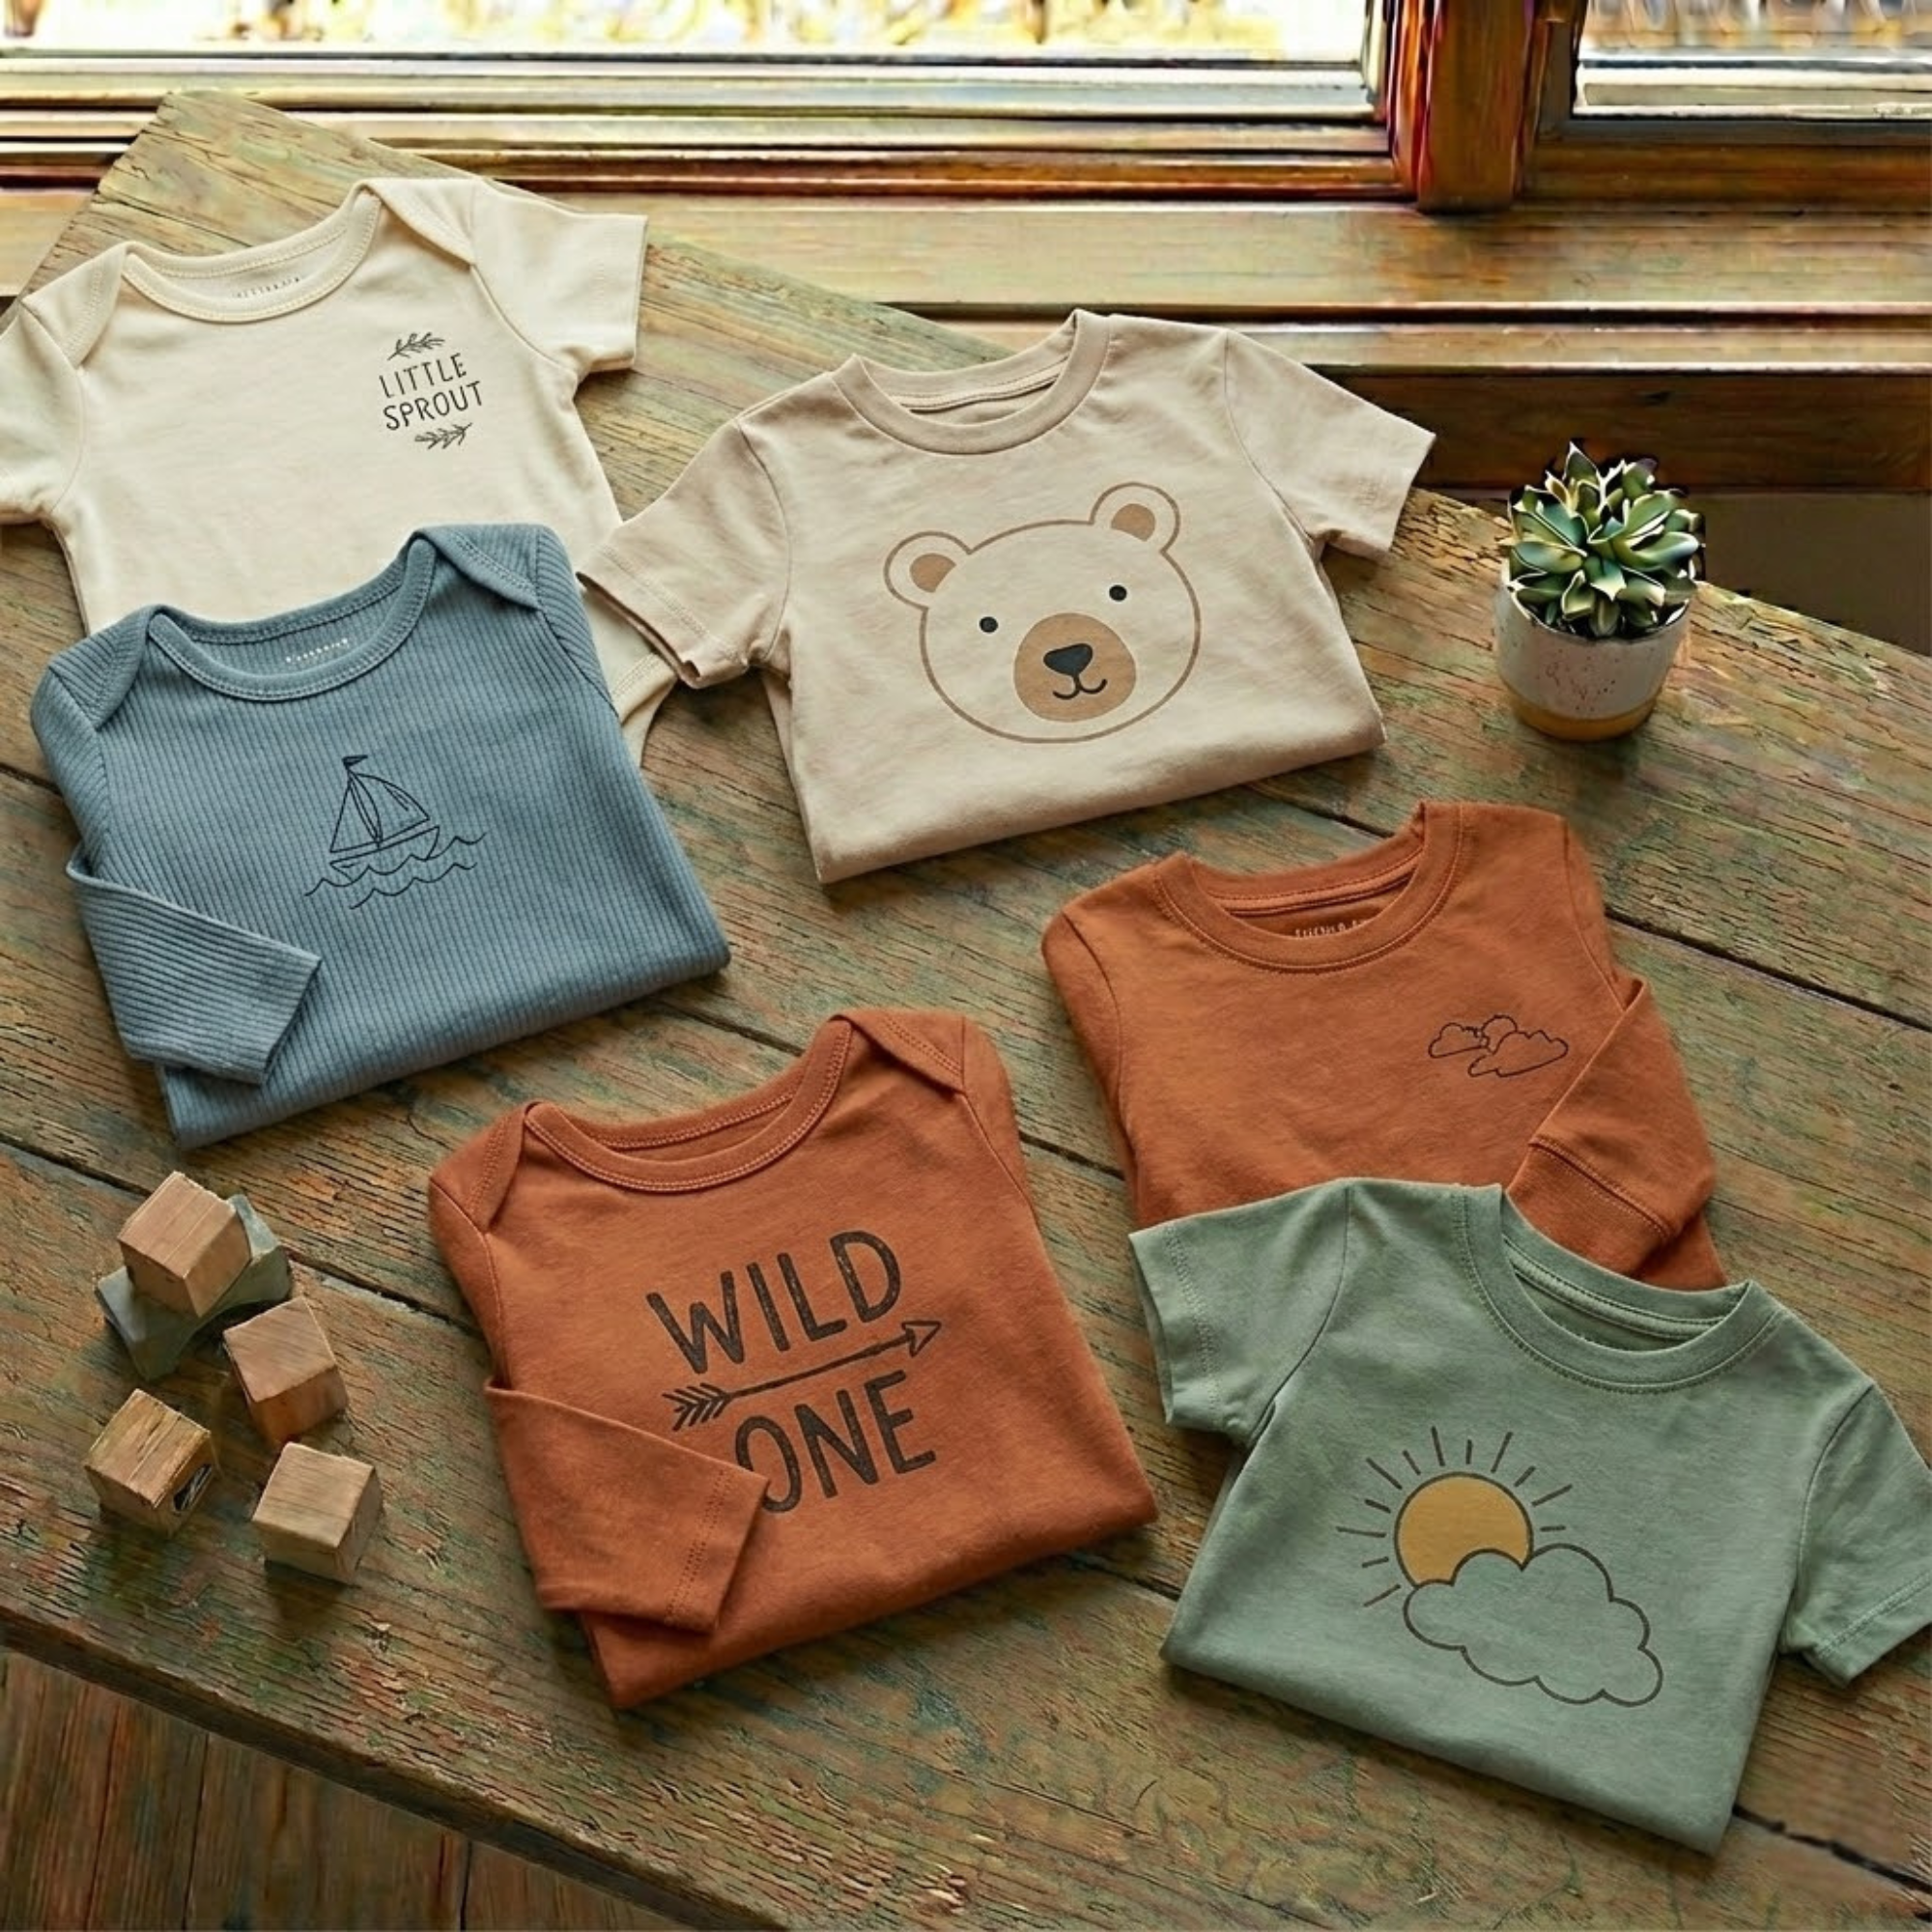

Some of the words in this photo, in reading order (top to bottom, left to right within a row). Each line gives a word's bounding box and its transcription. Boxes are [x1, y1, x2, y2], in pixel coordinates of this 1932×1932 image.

[379, 353, 467, 398] LITTLE
[383, 380, 482, 431] SPROUT
[646, 1231, 901, 1374] WILD
[735, 1370, 936, 1514] ONE
